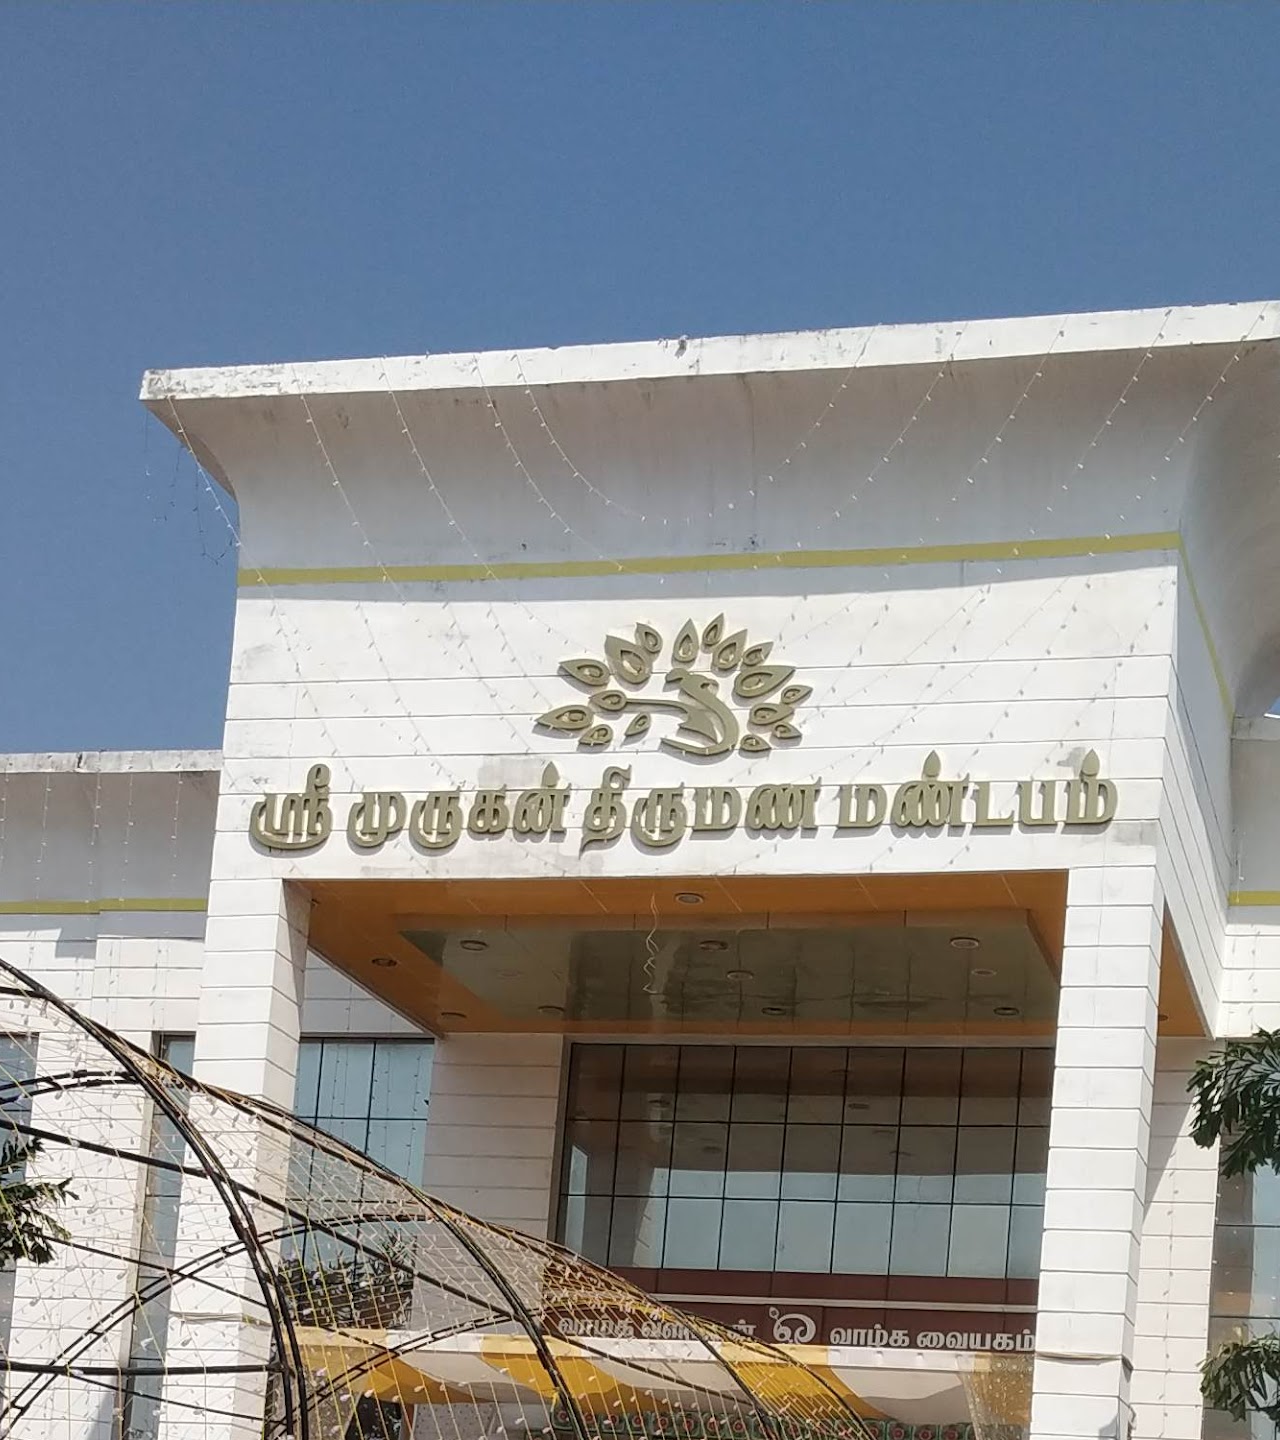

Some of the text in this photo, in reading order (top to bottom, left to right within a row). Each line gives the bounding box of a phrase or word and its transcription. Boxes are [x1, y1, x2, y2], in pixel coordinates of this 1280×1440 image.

[347, 761, 571, 849] முருகன்
[578, 764, 822, 860] திருமண
[835, 748, 1118, 830] மண்டபம்
[829, 1323, 911, 1348] வாழ்க
[916, 1328, 1036, 1352] வையகம்
